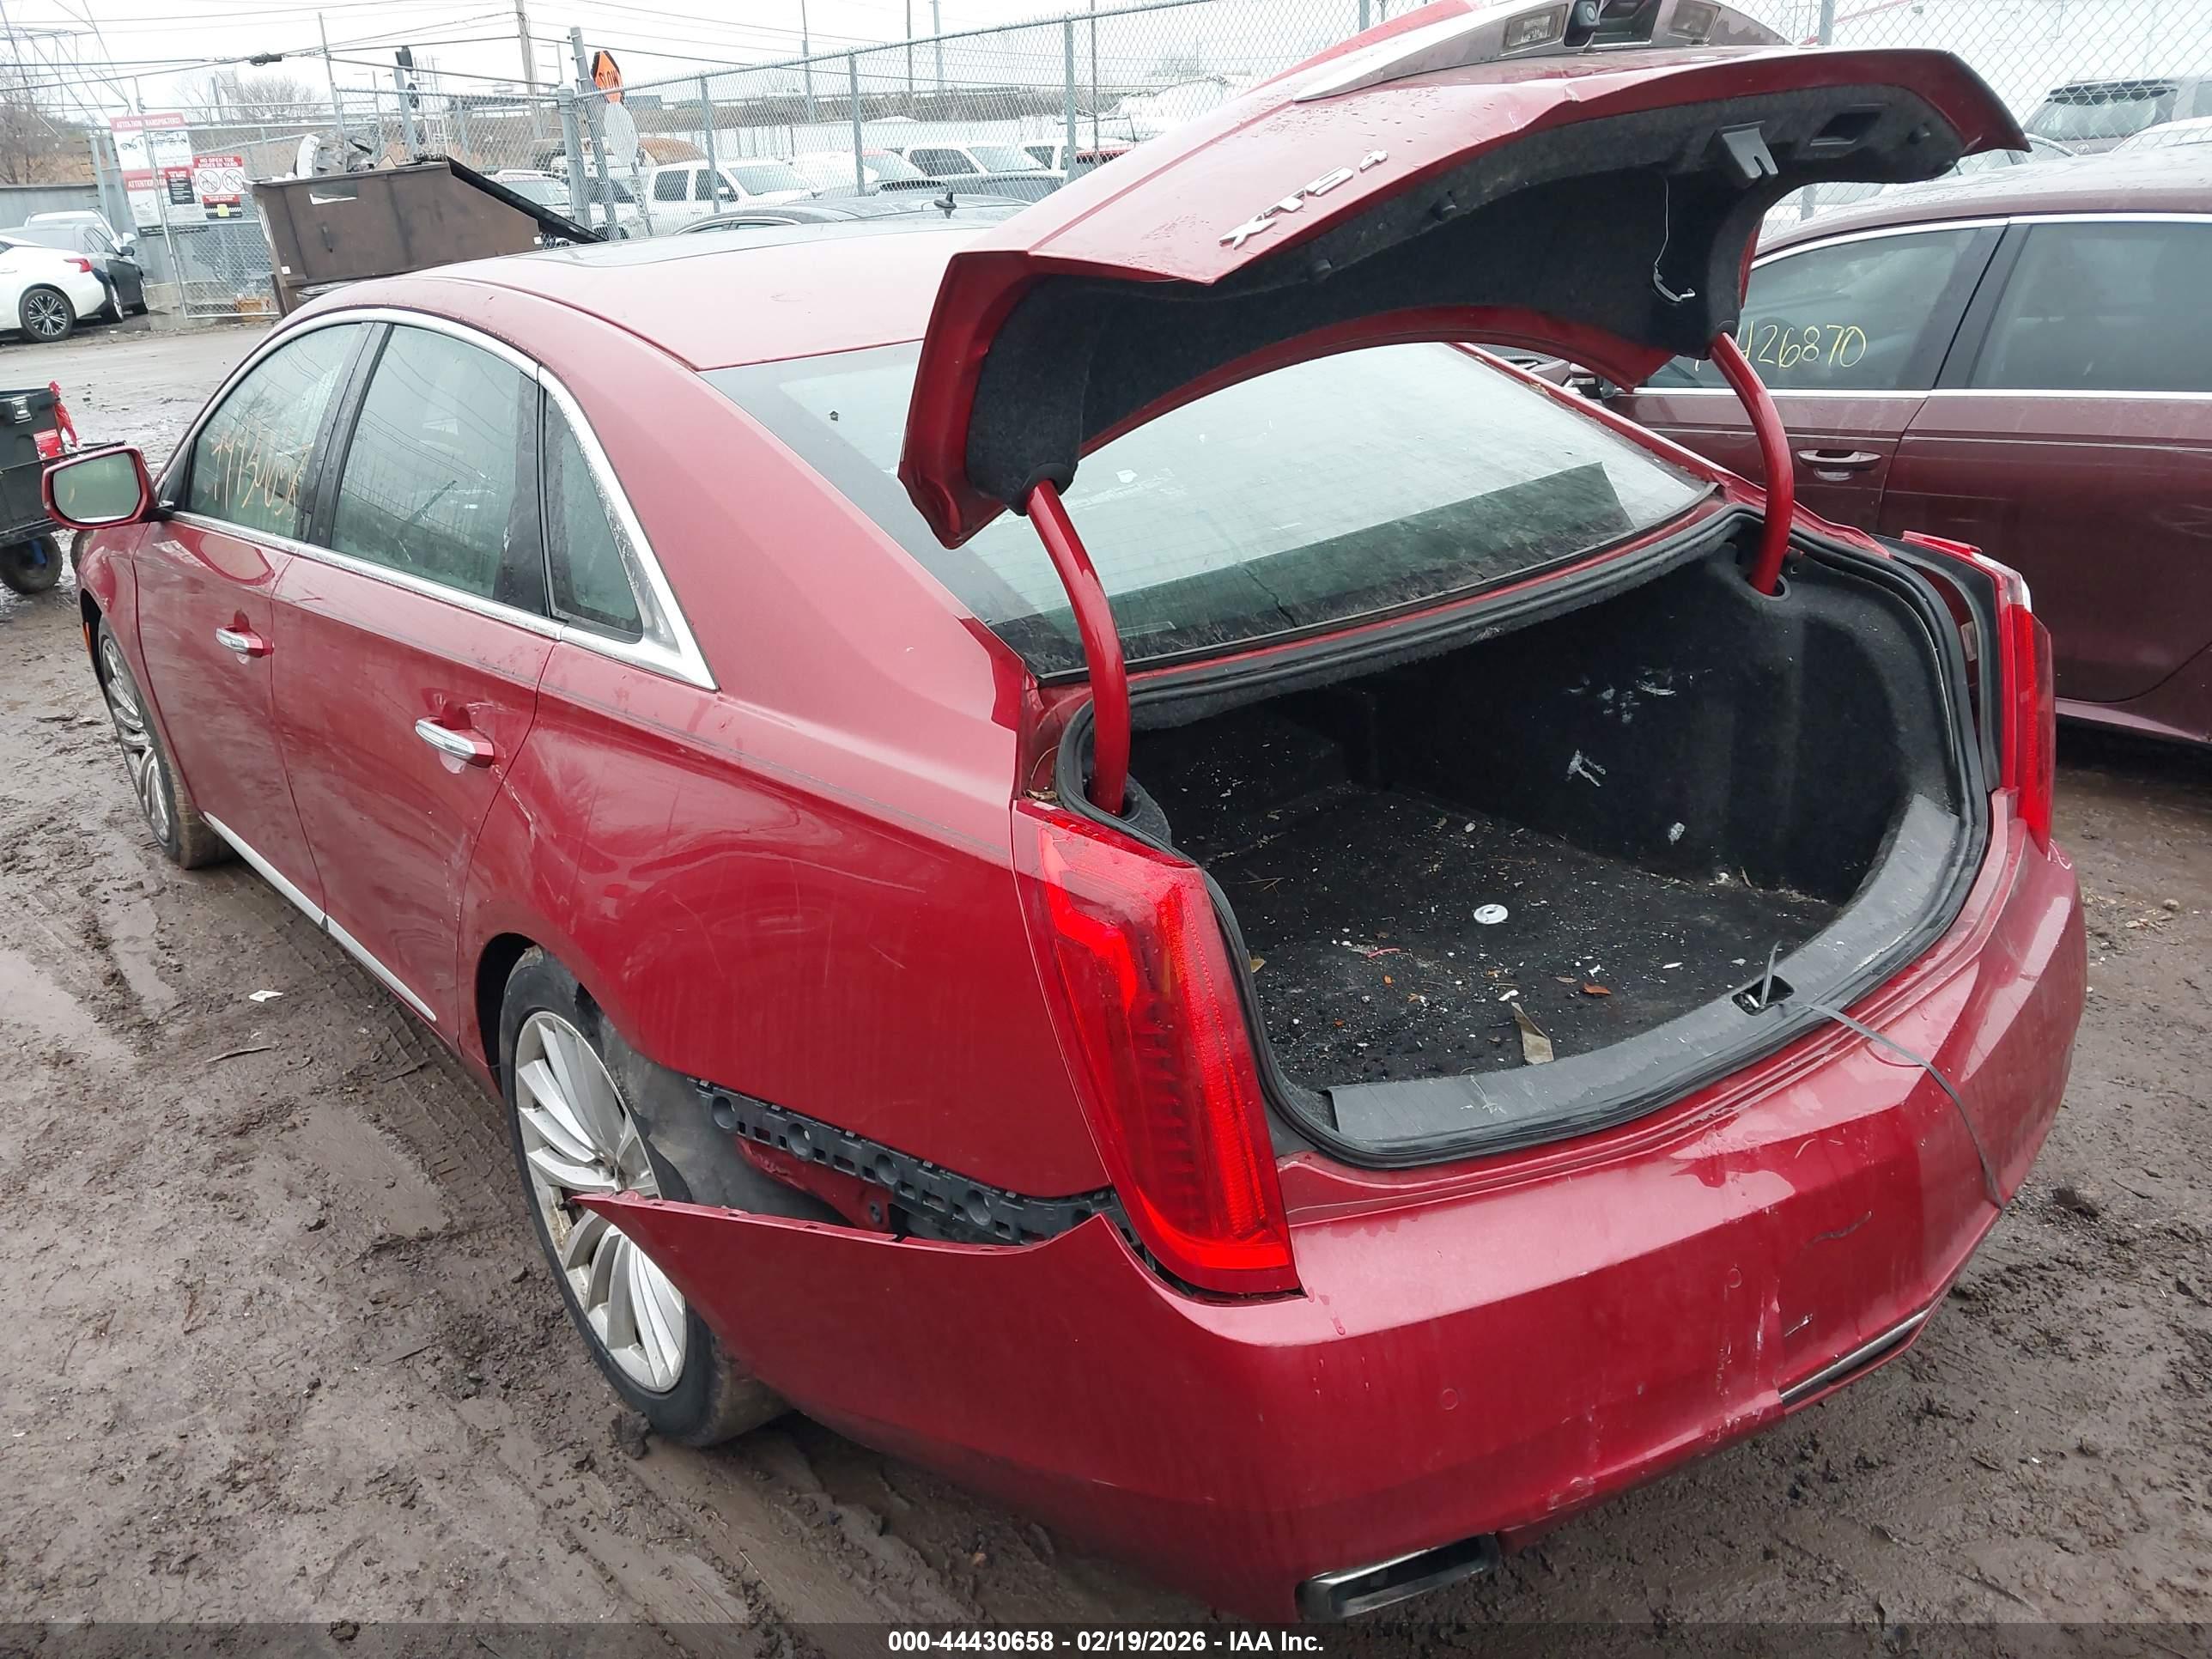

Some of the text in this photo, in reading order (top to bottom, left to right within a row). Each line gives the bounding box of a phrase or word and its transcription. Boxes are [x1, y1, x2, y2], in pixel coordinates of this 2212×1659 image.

[599, 70, 620, 89] SLOW
[1218, 149, 1389, 250] XTS 4
